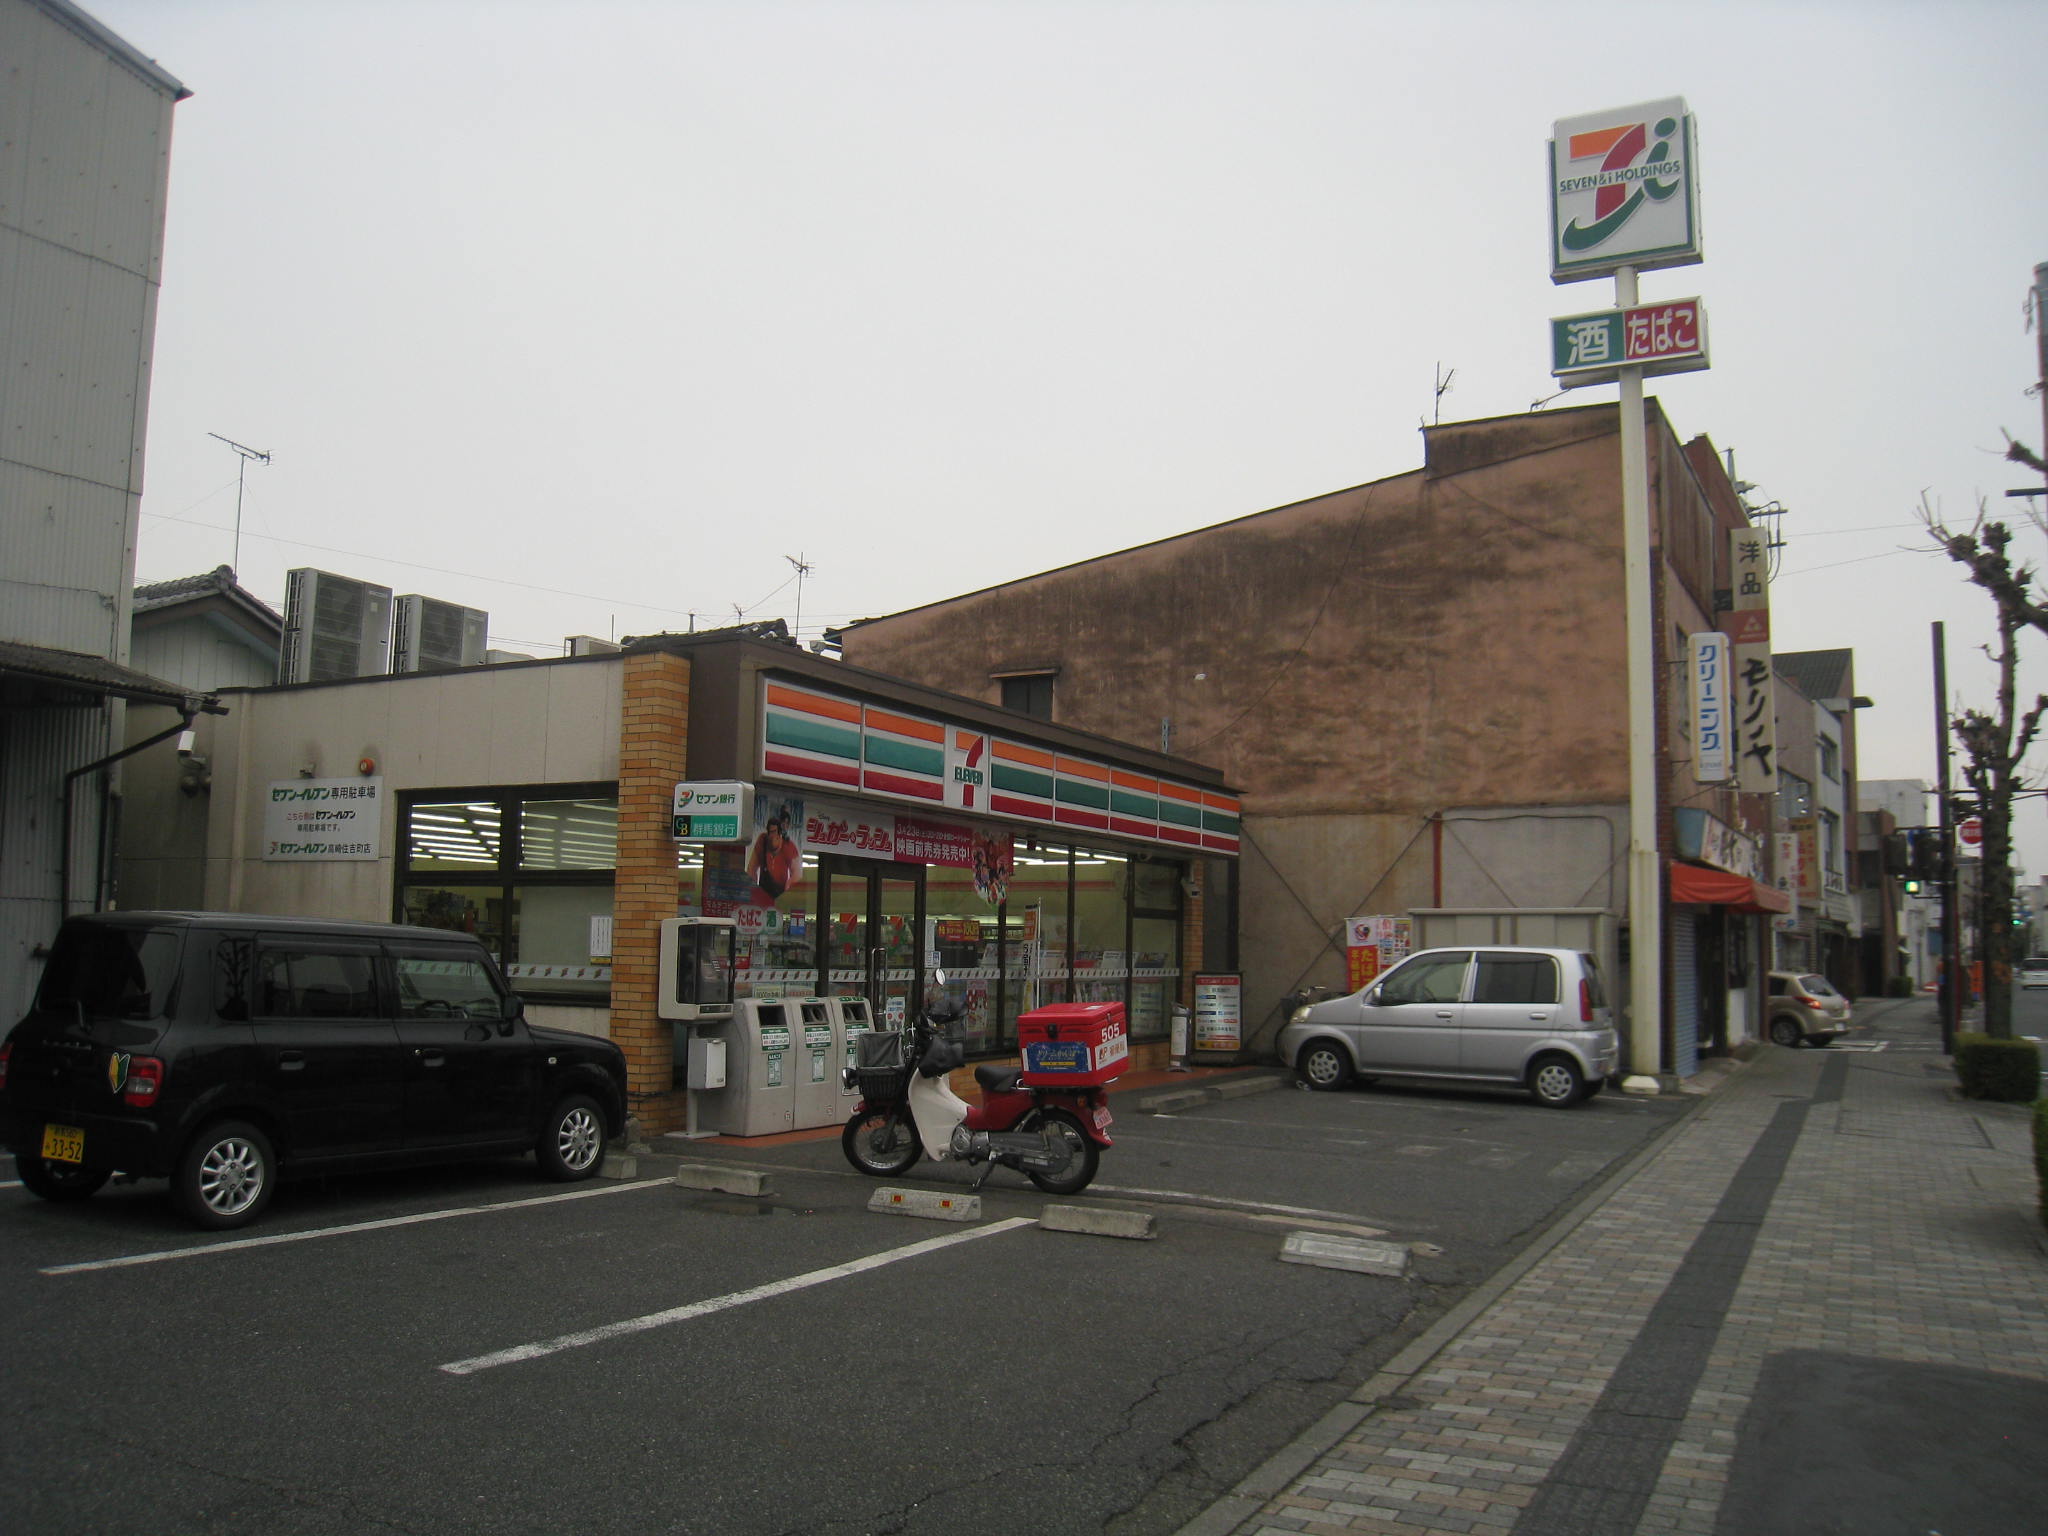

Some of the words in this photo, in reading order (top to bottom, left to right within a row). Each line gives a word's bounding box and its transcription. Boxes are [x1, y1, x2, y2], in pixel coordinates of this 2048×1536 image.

[1614, 159, 1681, 183] HOLDINGS
[1567, 318, 1610, 366] 酒
[1627, 307, 1697, 356] たばこ
[1739, 540, 1761, 596] 洋品
[1699, 644, 1721, 752] クリーニング
[1740, 657, 1773, 777] モリノヤ
[954, 766, 984, 786] ELEVEN
[696, 793, 736, 805] セブン銀行
[693, 823, 737, 837] 群馬銀行
[806, 818, 893, 852] シュガー・ラッシュ
[737, 909, 763, 927] たばこ
[1101, 1023, 1121, 1043] 505
[50, 1137, 83, 1161] 33-52
